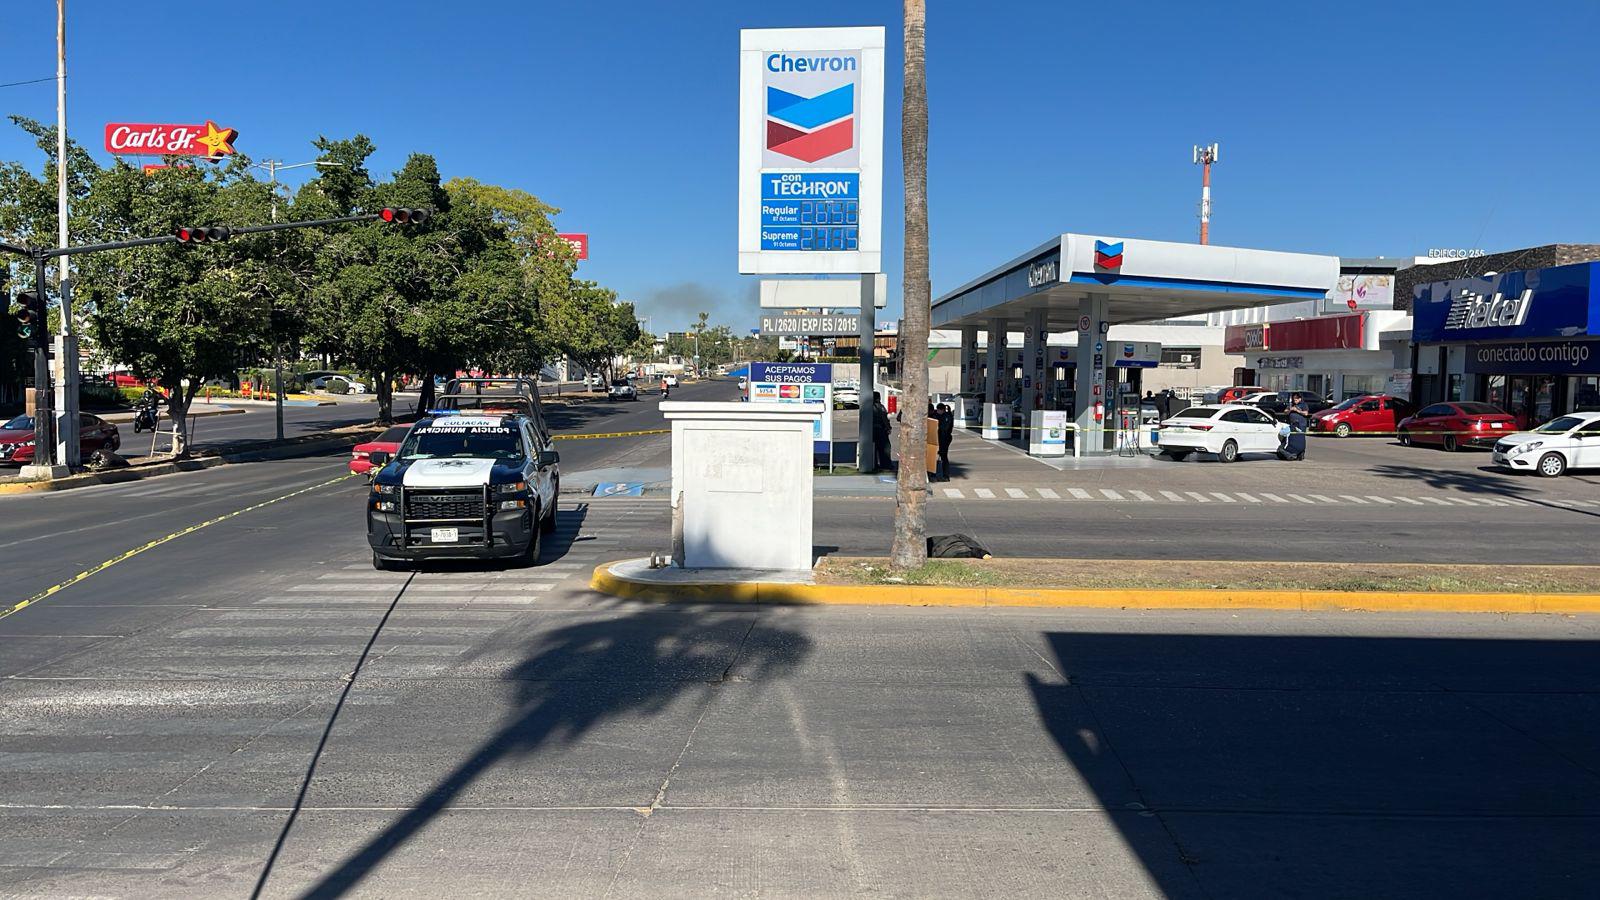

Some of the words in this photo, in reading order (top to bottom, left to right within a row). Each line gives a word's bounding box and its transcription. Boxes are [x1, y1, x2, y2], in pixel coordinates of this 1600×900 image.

[767, 53, 857, 73] Chevron
[110, 126, 166, 149] Carl's
[167, 127, 200, 151] Jr.
[781, 174, 802, 182] con
[771, 179, 850, 199] TECHRON
[762, 205, 799, 217] Regular
[762, 231, 799, 242] Supreme
[1428, 248, 1467, 259] EDIFICIO
[1469, 249, 1485, 258] 255
[1464, 289, 1534, 329] telcel
[1477, 343, 1537, 363] conectado
[1539, 342, 1589, 366] contigo
[764, 366, 815, 374] ACEPTAMOS
[765, 375, 782, 383] SUS
[783, 375, 812, 383] PAGOS
